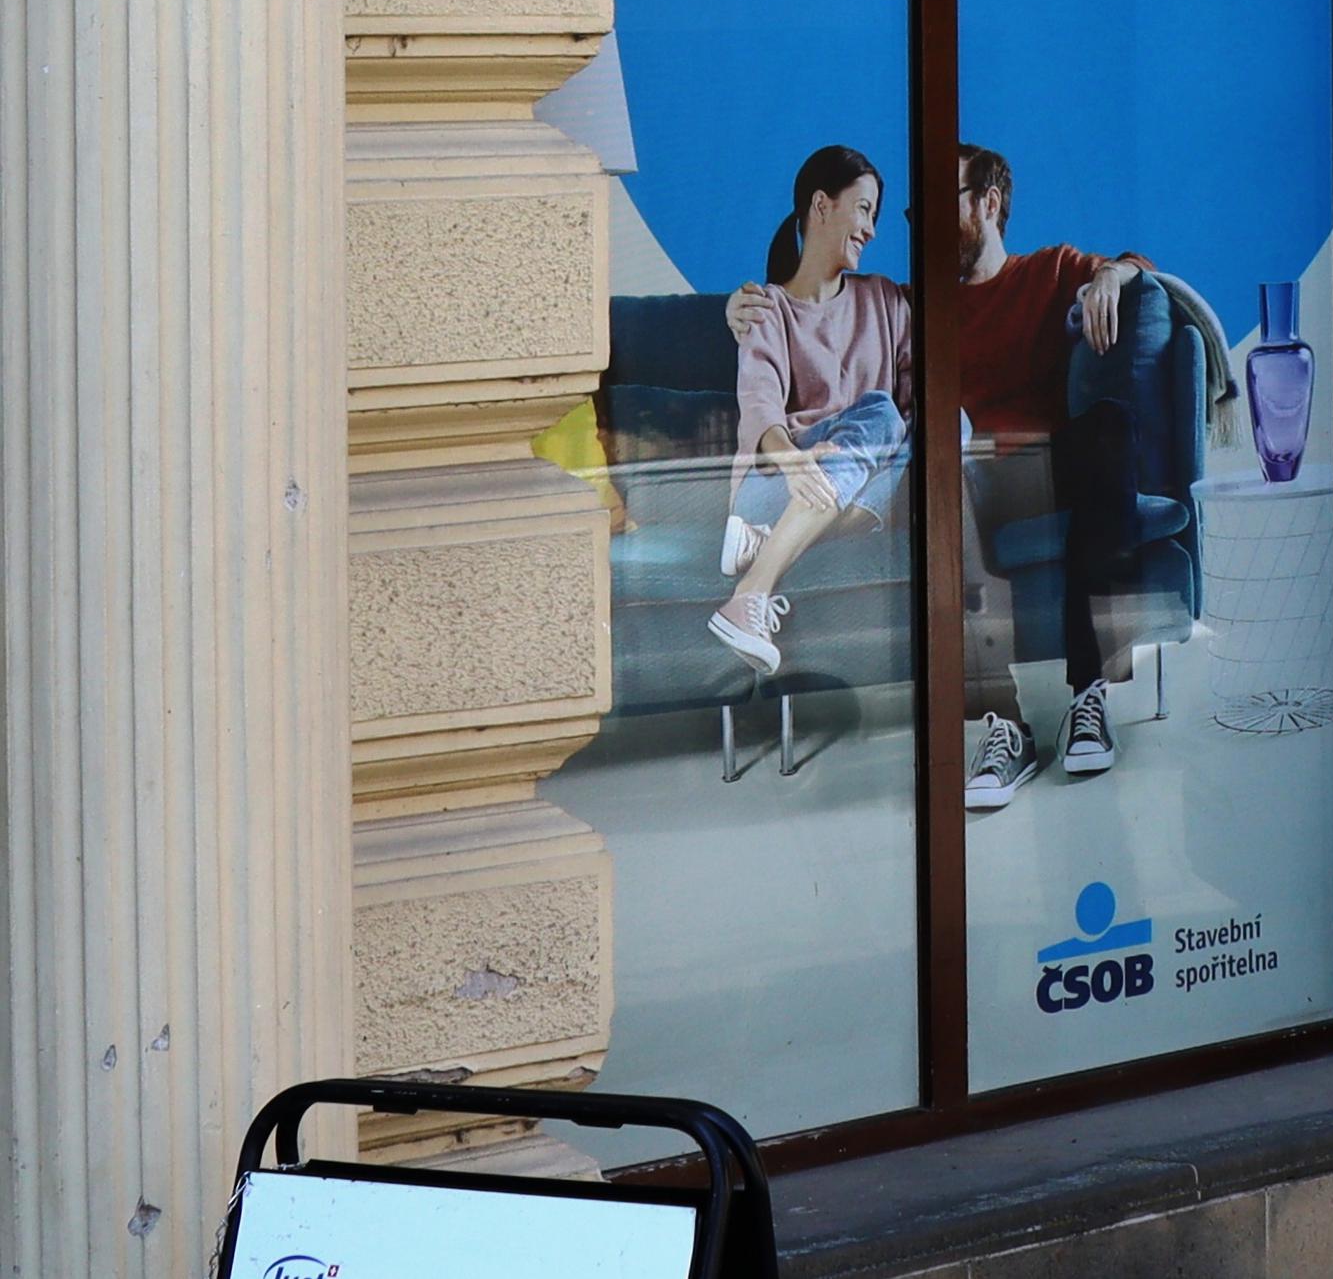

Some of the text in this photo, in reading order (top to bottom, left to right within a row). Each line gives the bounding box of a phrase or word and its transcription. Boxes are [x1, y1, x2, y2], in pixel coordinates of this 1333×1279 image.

[1175, 913, 1263, 953] Stavební
[1036, 953, 1155, 1014] ČSOB
[1175, 948, 1279, 993] spořitelna
